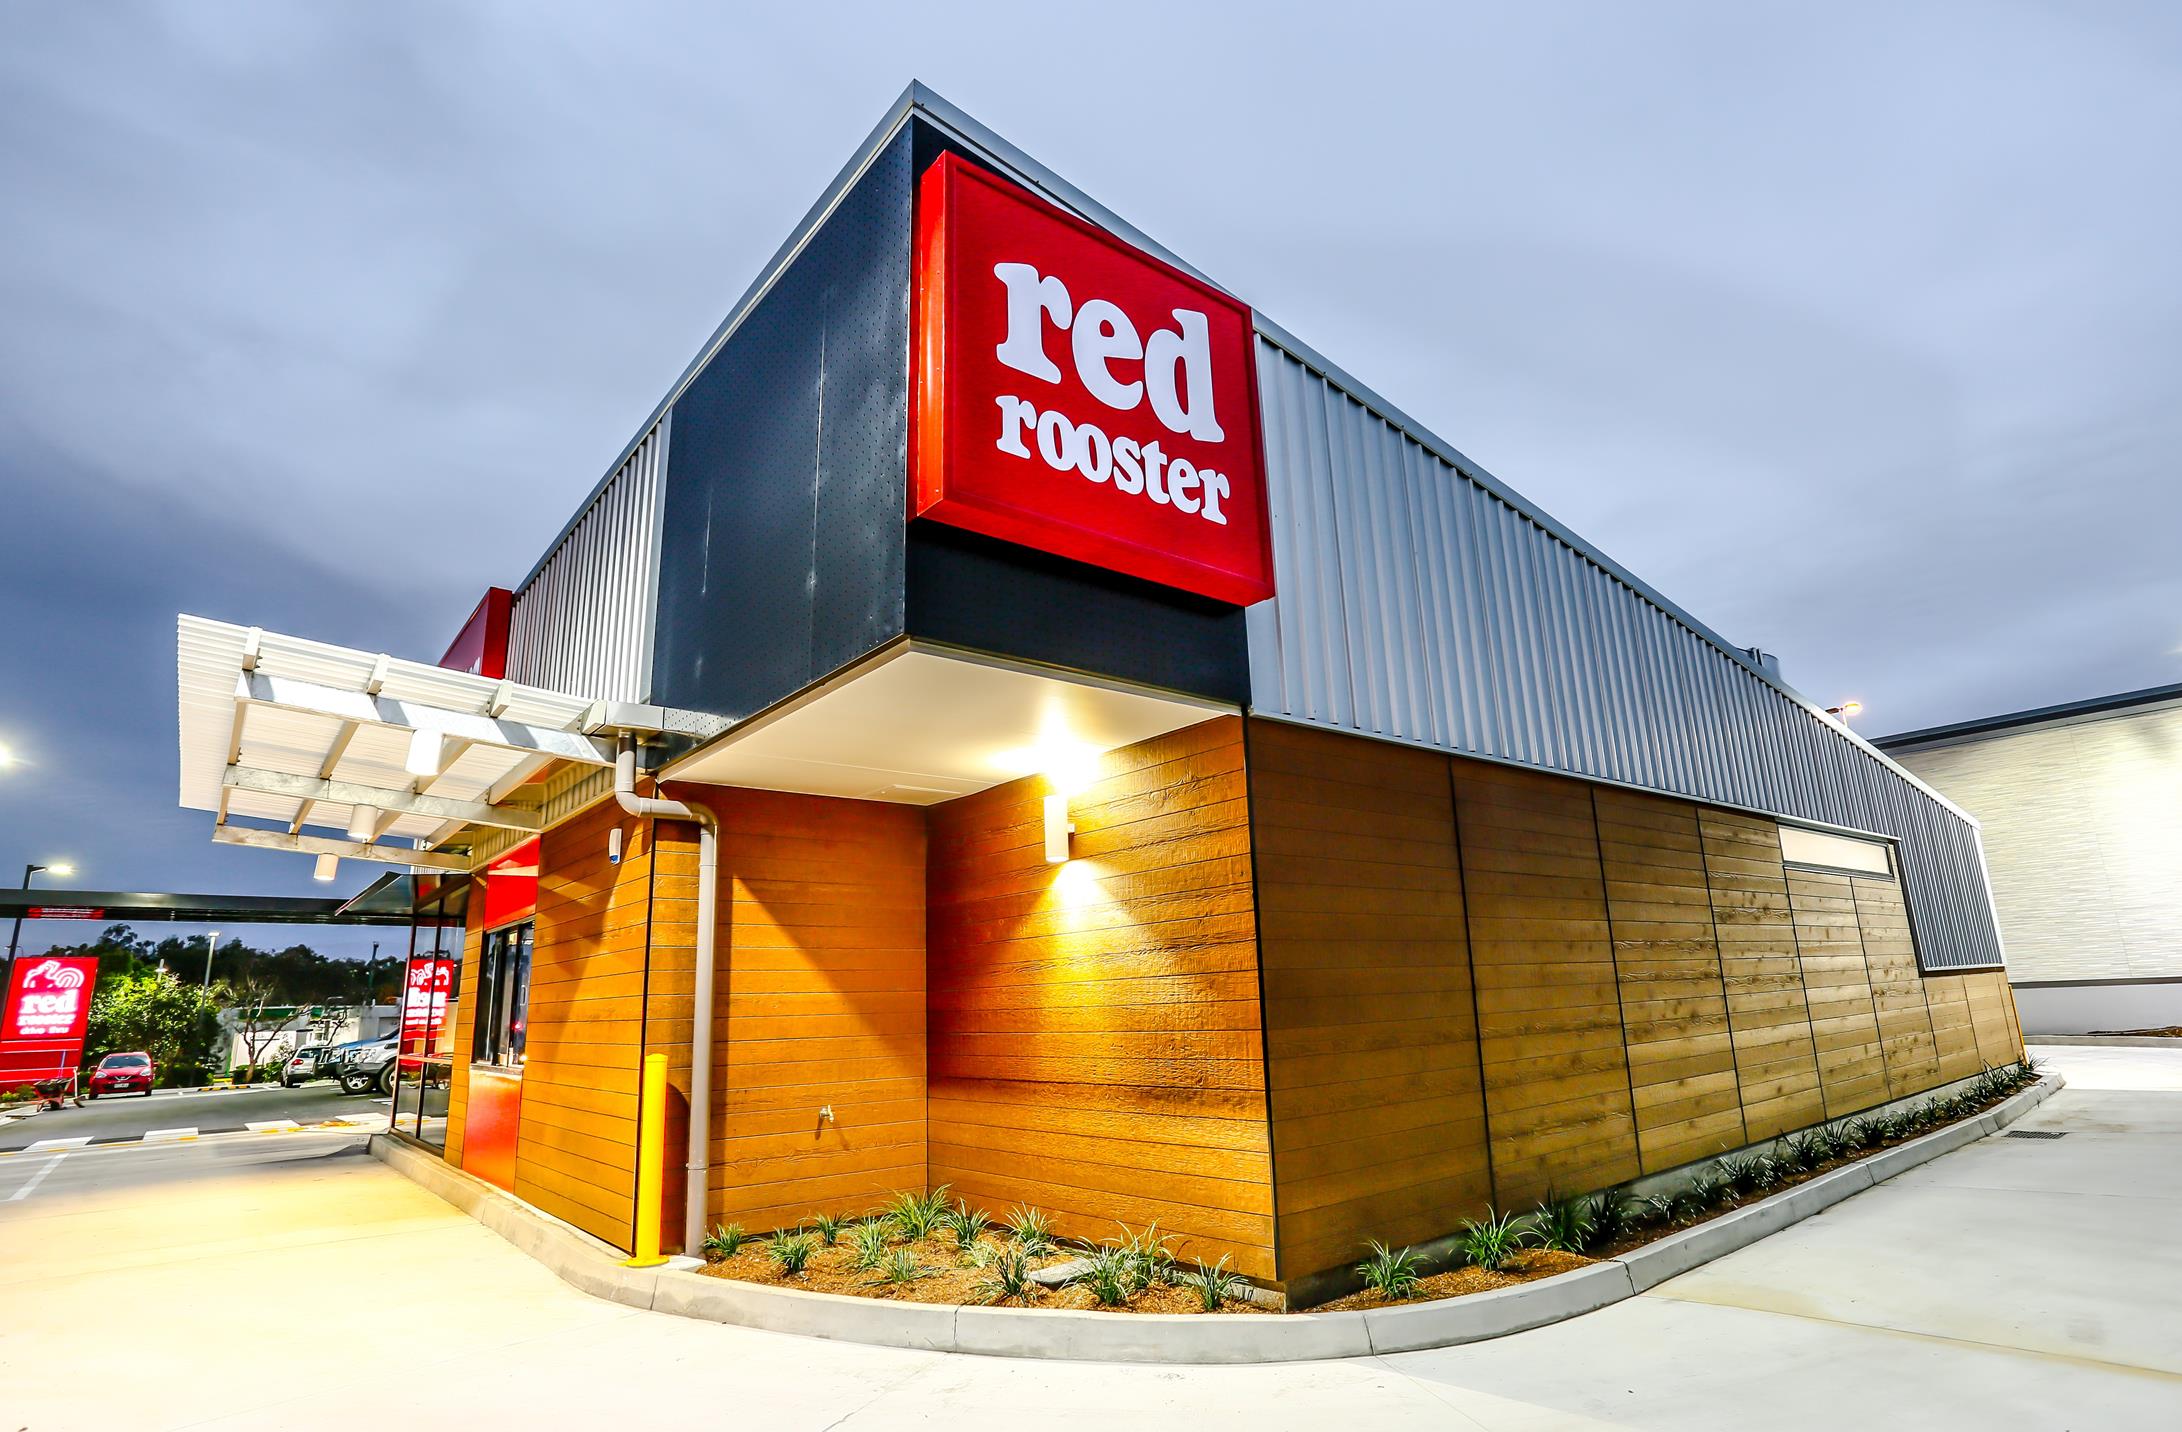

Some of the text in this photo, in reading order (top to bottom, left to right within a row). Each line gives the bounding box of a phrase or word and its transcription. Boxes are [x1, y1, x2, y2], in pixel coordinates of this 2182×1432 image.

[993, 262, 1225, 443] red
[995, 395, 1231, 526] rooster
[18, 988, 79, 1014] red
